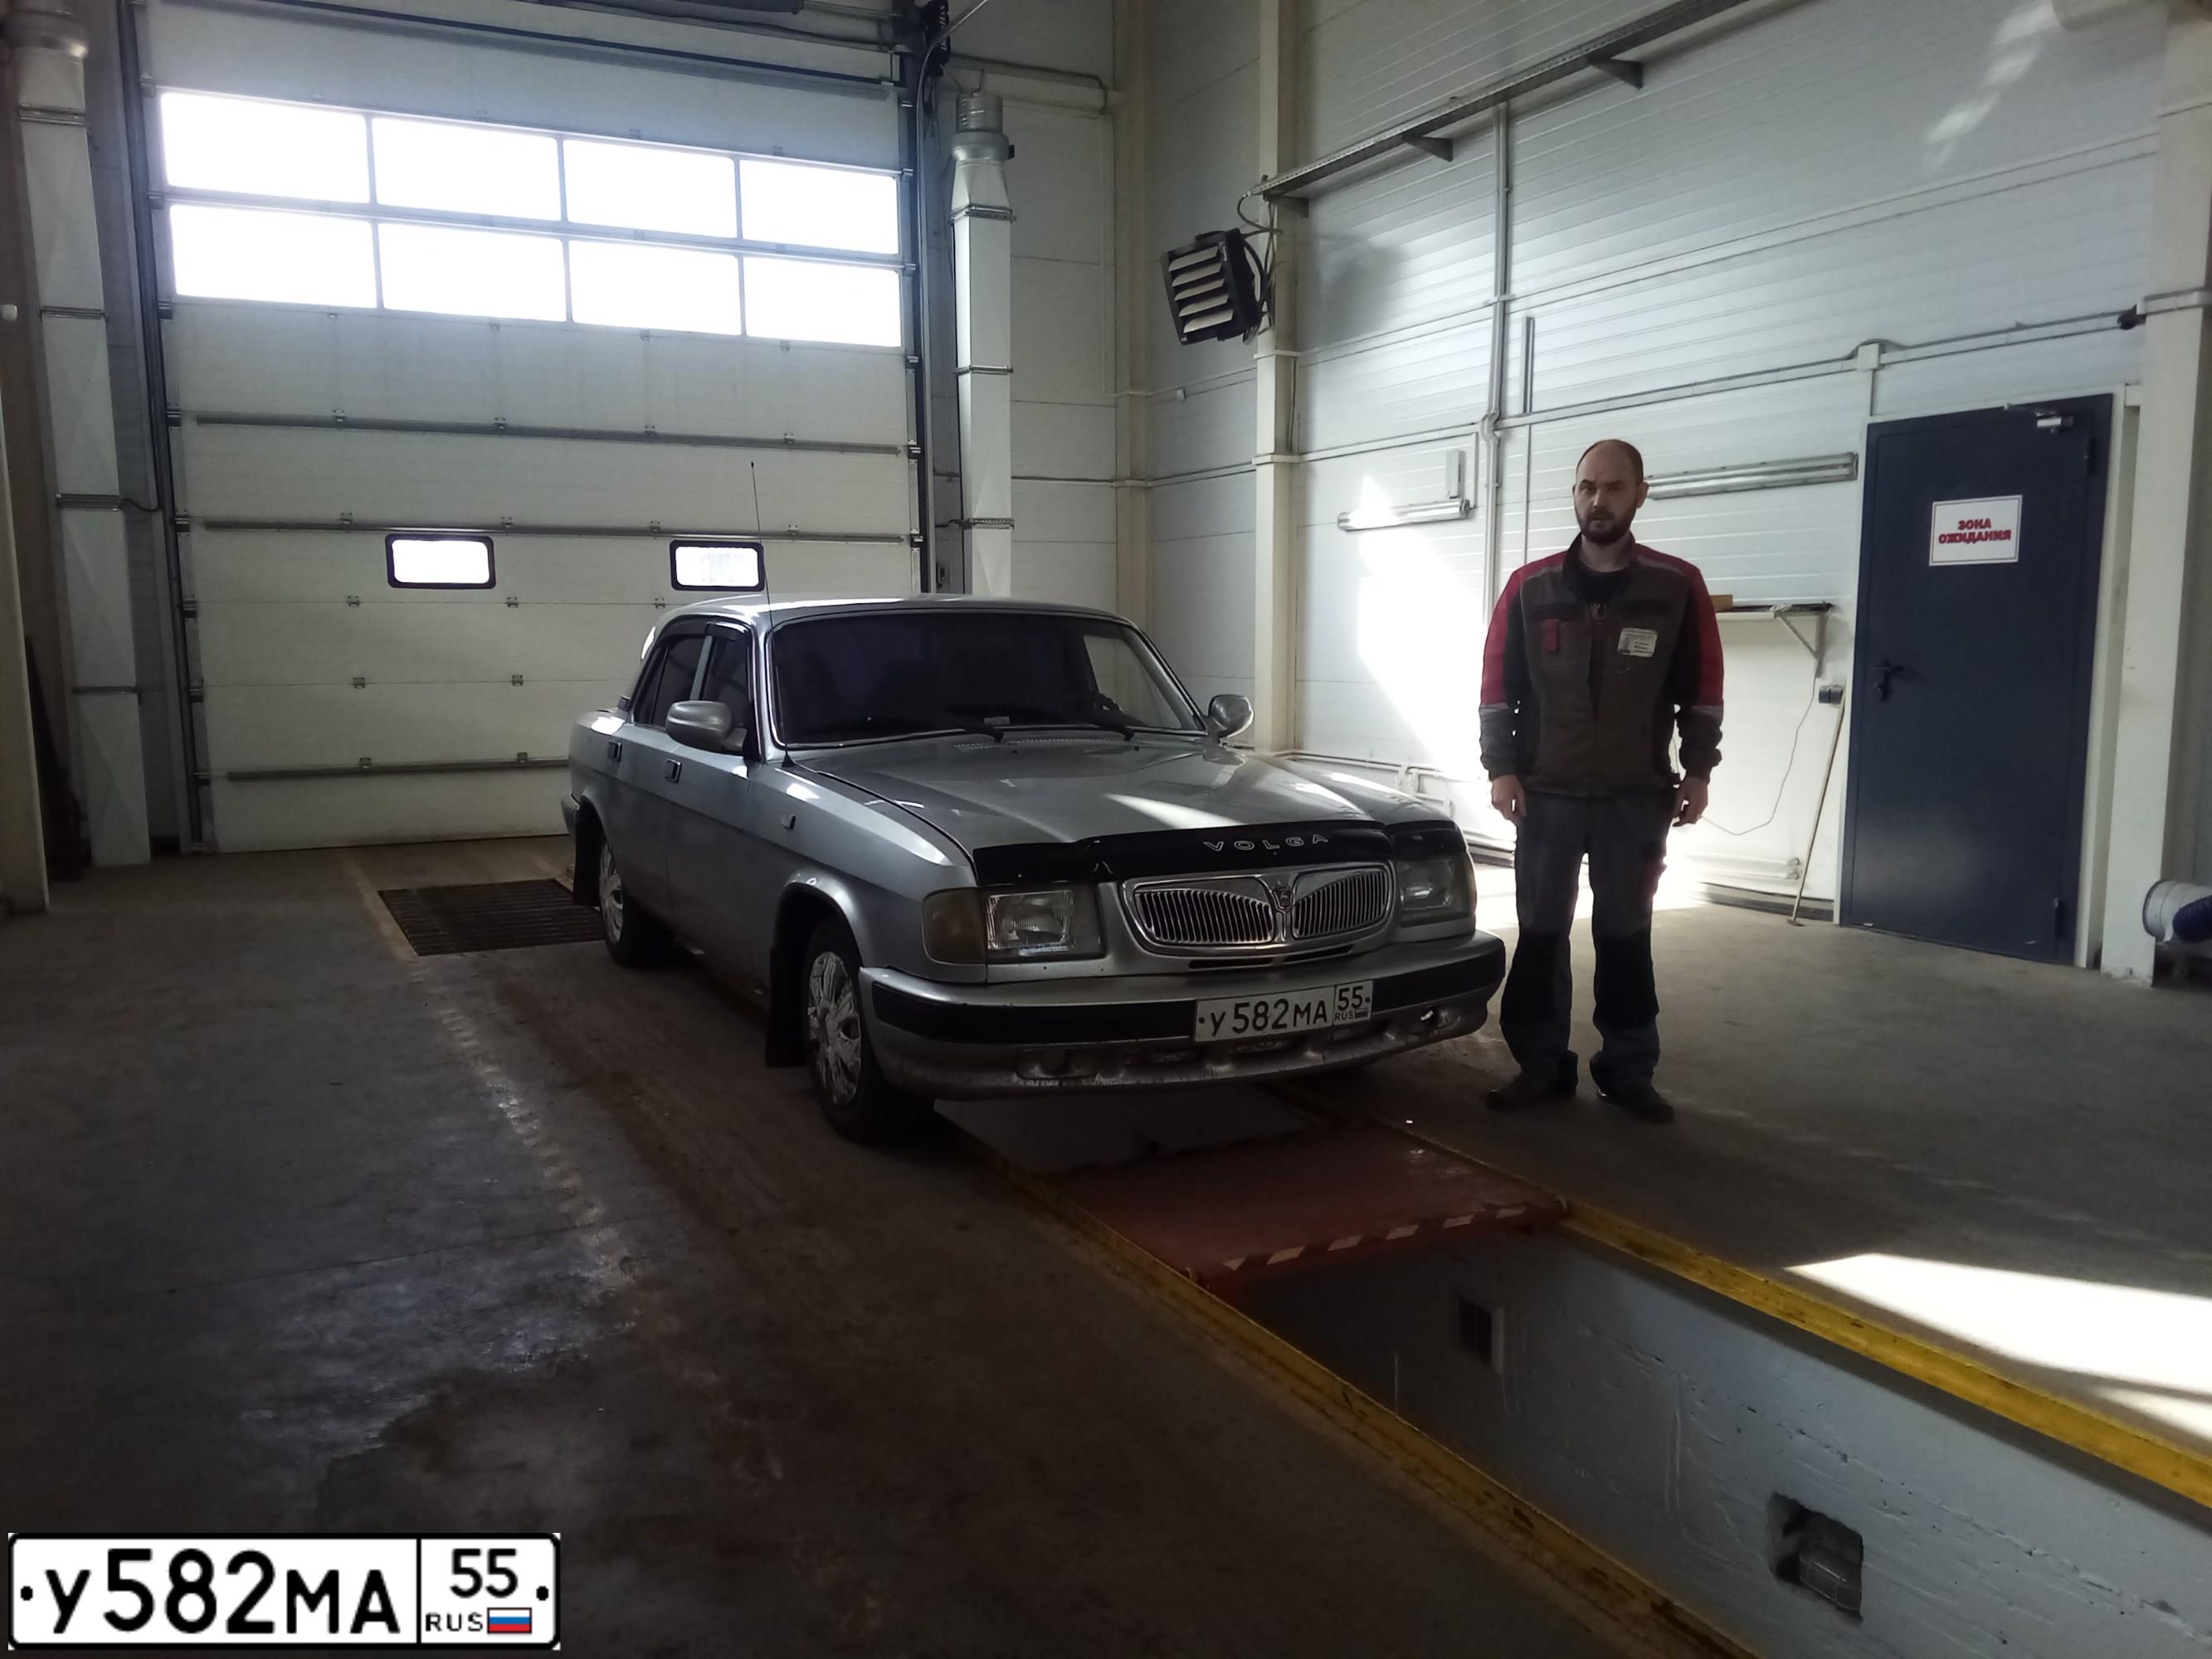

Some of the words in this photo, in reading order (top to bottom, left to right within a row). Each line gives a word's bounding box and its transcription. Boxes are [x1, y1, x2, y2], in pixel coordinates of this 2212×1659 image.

[1957, 518, 1992, 531] ЗОНА
[1938, 529, 2012, 544] ОЖИДАНИЯ
[1203, 834, 1328, 851] VOLGA
[1337, 985, 1363, 1011] 55
[1334, 1011, 1354, 1021] RUS
